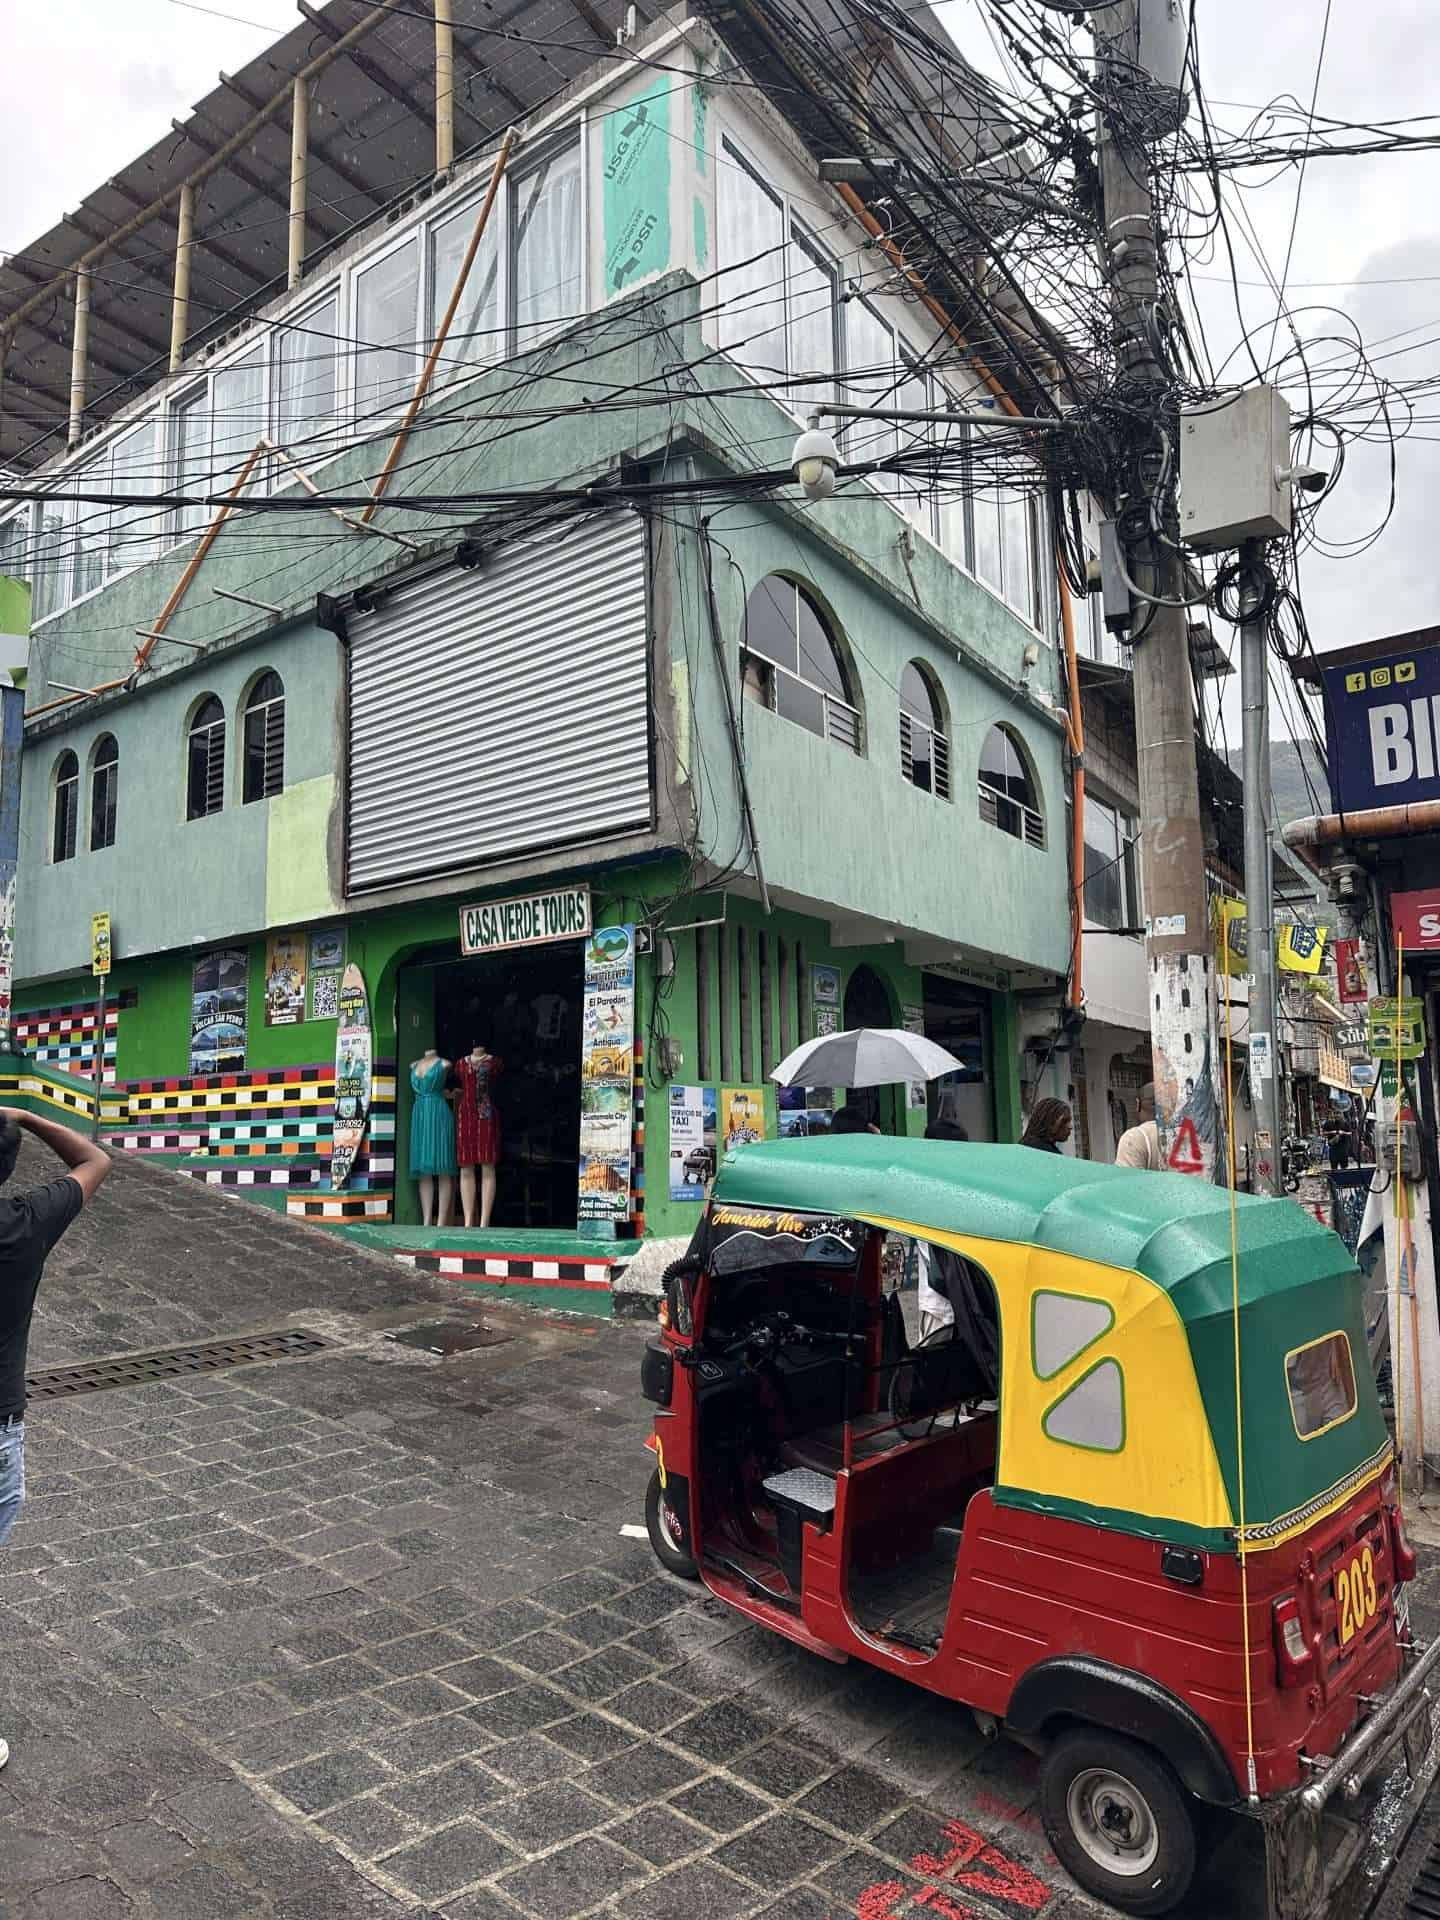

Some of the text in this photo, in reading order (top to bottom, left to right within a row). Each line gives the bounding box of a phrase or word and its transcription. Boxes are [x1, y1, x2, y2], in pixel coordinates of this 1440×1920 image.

[604, 141, 629, 179] USG
[631, 215, 657, 254] USG
[467, 891, 585, 948] CASA VERDE TOURS
[589, 998, 596, 1007] El
[215, 1013, 225, 1024] SAN
[226, 1013, 244, 1027] PEDRO
[593, 1038, 621, 1048] Antigua
[615, 1112, 627, 1122] City
[672, 1116, 689, 1126] TAXI
[581, 1200, 594, 1208] And
[776, 1212, 805, 1232] Vive
[1338, 1546, 1377, 1645] 203
